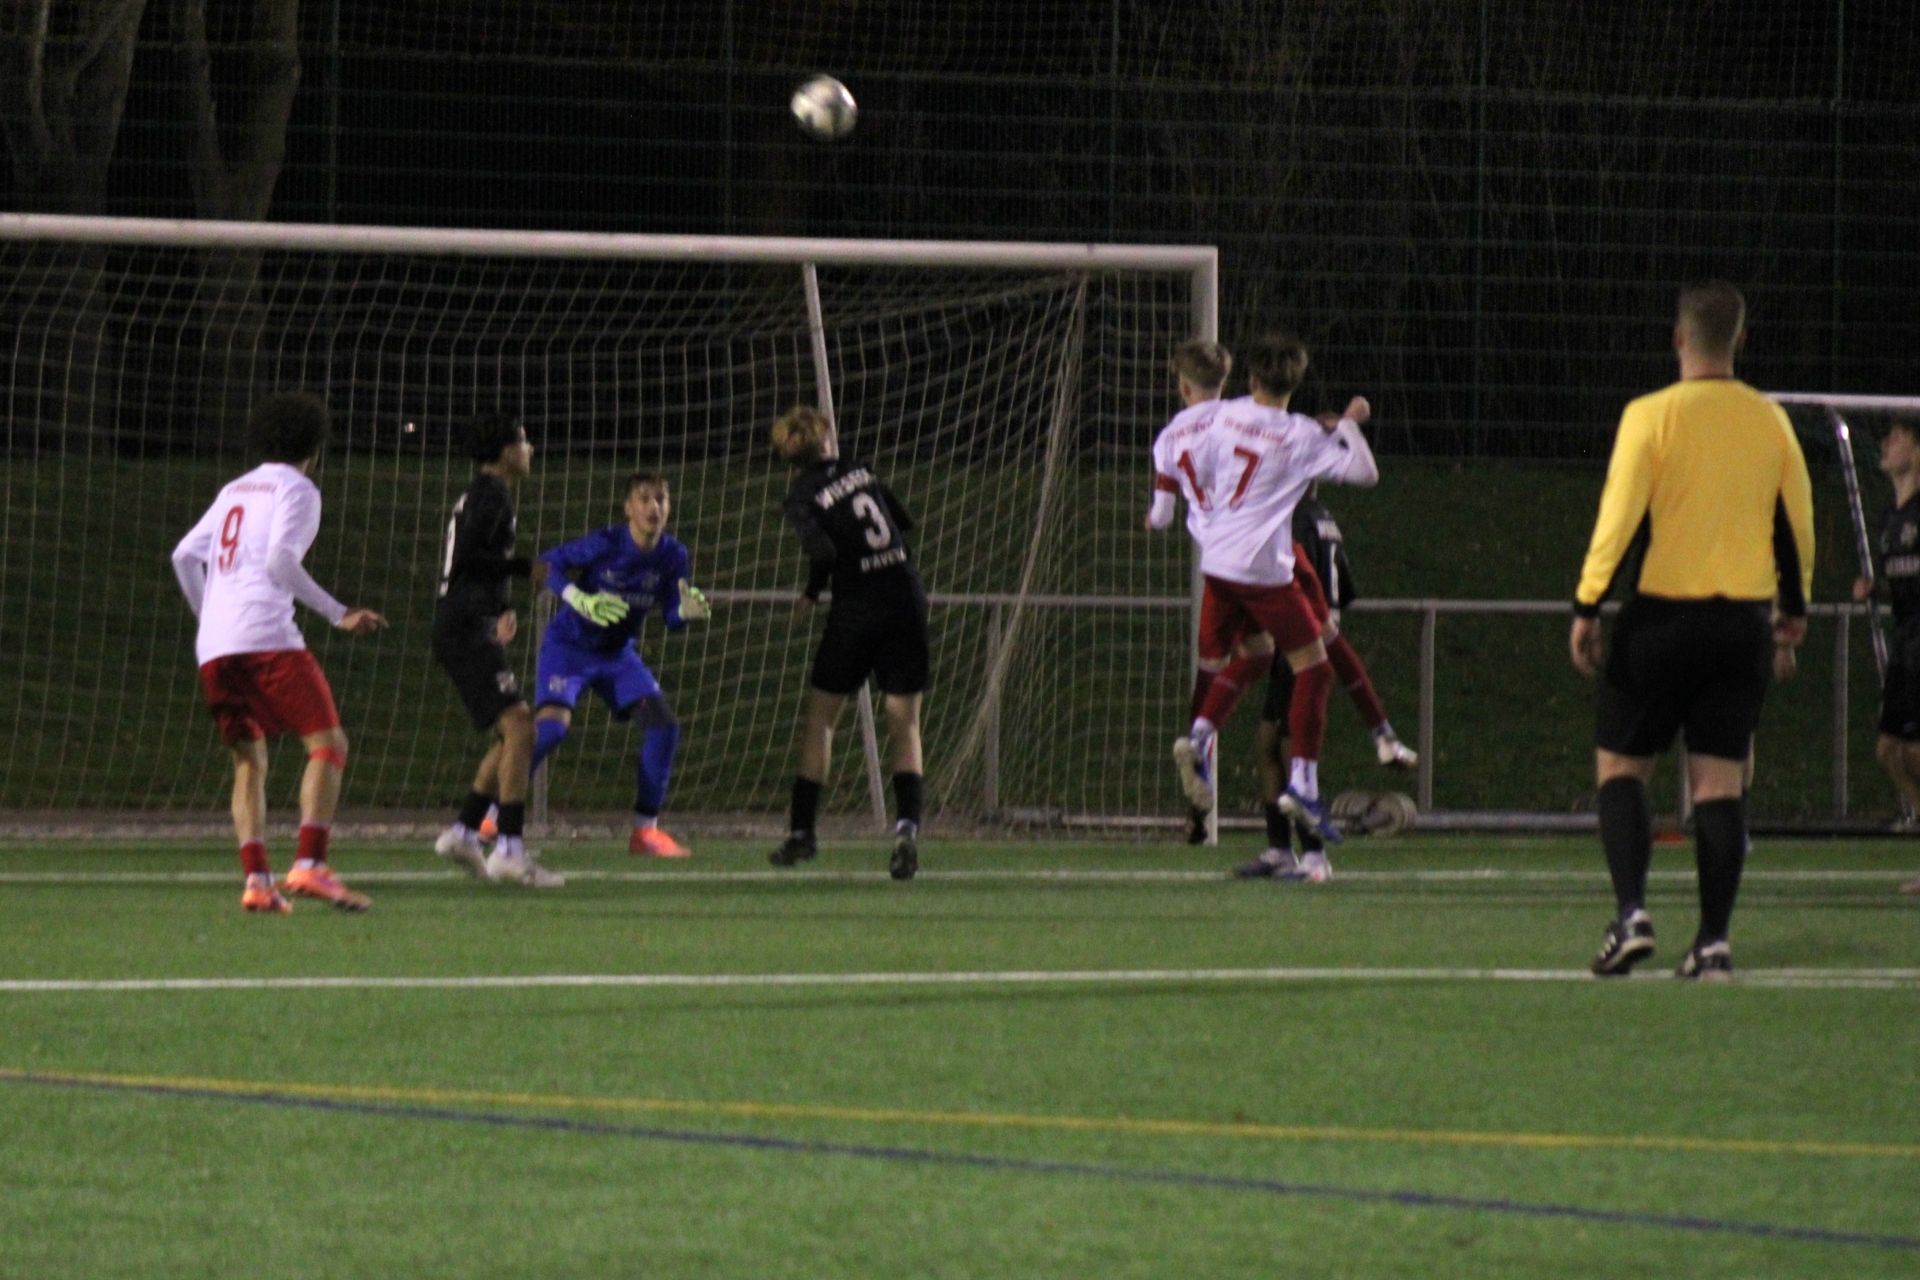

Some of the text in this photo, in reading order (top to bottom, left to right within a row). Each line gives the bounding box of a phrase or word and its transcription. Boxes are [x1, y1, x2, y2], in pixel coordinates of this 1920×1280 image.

[1229, 446, 1260, 509] 7
[218, 504, 246, 575] 9
[853, 493, 891, 548] 3
